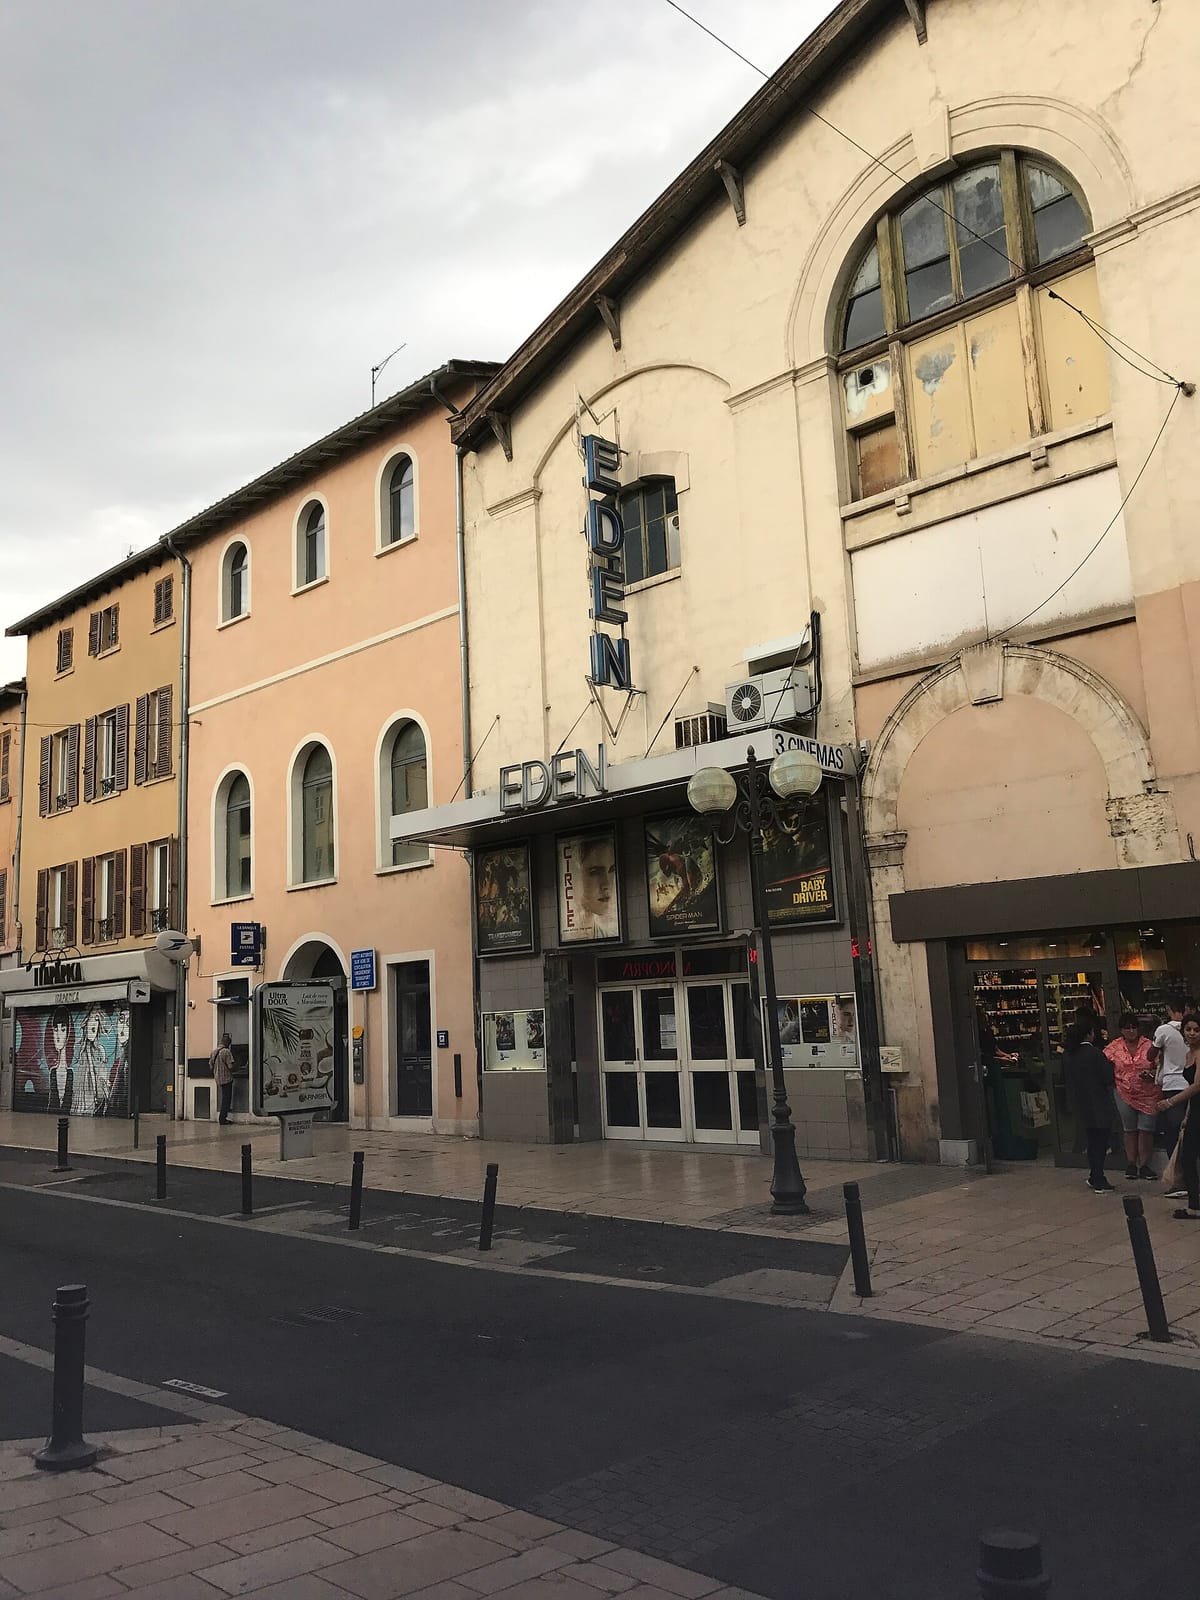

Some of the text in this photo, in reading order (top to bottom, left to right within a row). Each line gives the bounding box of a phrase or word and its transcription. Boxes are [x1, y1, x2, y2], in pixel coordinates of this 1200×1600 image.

[586, 434, 632, 687] EDEN
[499, 743, 607, 813] EDEN
[774, 733, 844, 770] 3 CINEMAS
[563, 846, 575, 928] CIRCLE
[793, 890, 828, 904] DRIVER
[800, 878, 826, 892] BABY
